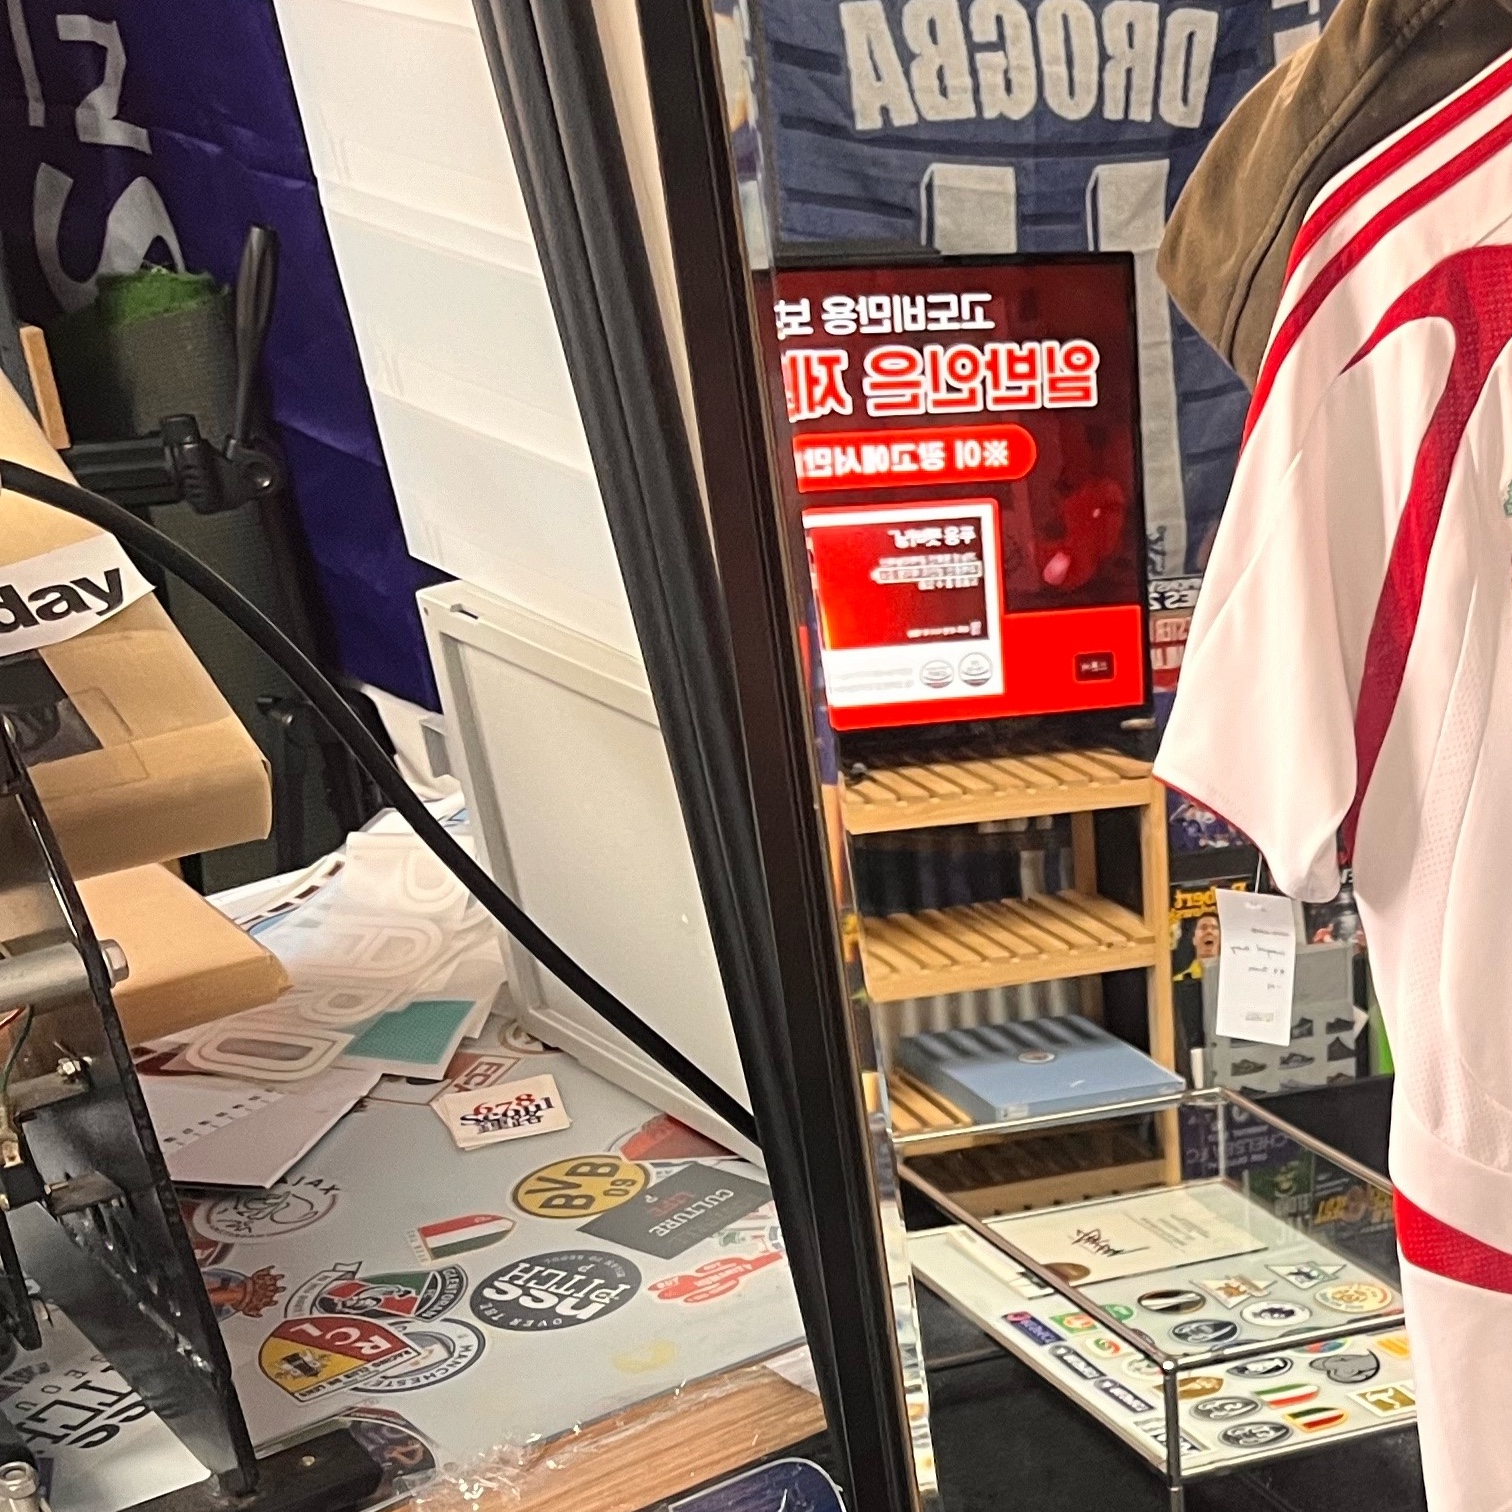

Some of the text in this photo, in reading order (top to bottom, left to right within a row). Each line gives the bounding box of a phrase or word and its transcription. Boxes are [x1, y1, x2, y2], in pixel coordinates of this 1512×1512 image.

[0, 568, 125, 633] day
[473, 1093, 536, 1116] 678
[524, 1162, 619, 1210] BVB
[603, 1178, 636, 1197] 09
[648, 1188, 734, 1237] CULTURE
[482, 1281, 606, 1320] nss
[498, 1262, 631, 1304] PITCH
[288, 1322, 392, 1356] RCL
[508, 1317, 563, 1328] OVER
